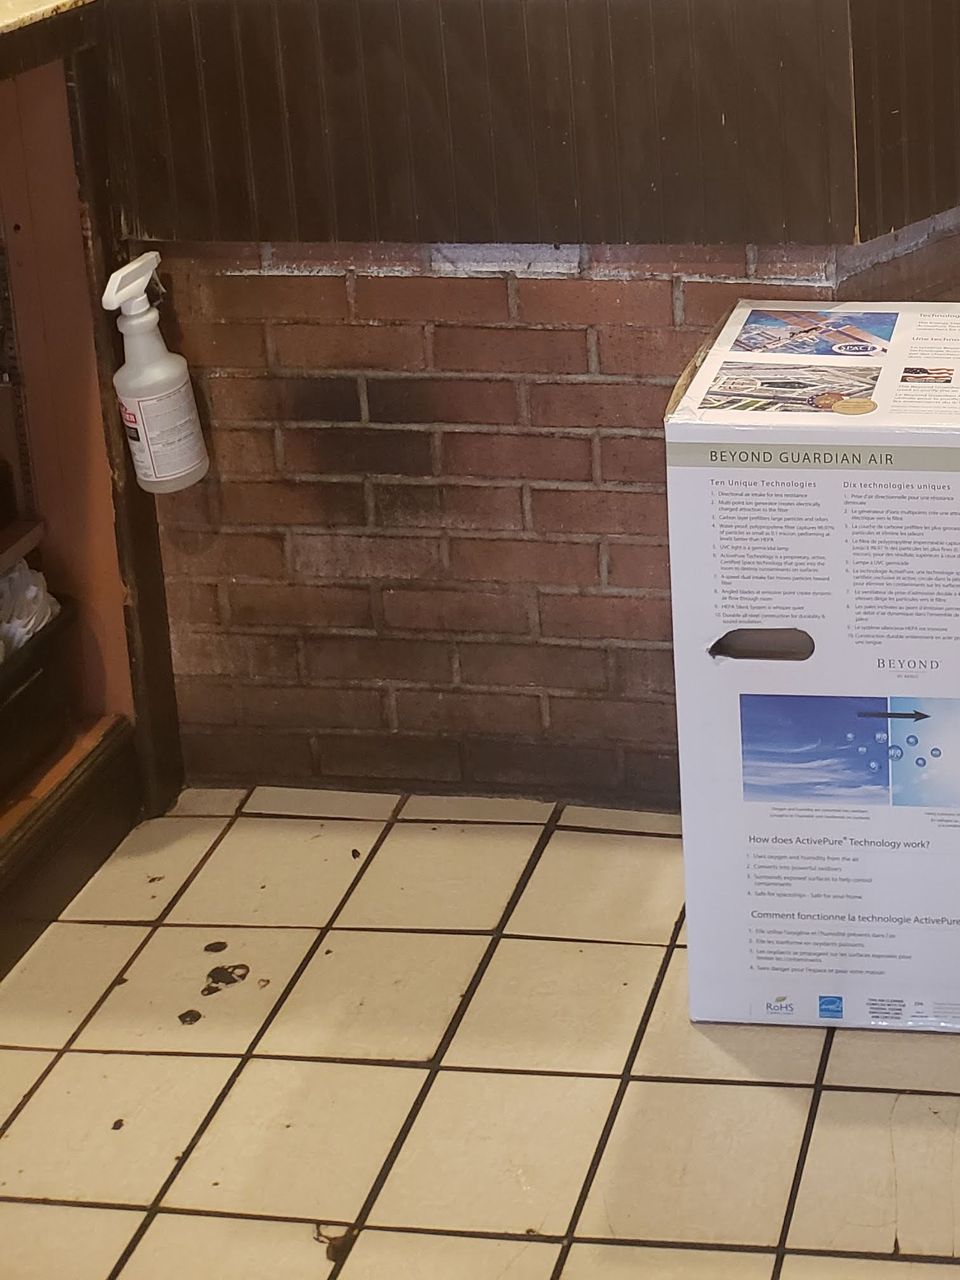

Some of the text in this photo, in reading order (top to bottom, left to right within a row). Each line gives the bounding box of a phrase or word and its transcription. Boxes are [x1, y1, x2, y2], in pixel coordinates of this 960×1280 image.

[710, 450, 894, 465] BEYOND GUARDIAN AIR
[728, 480, 758, 488] Unique
[761, 480, 817, 489] Technologies
[843, 481, 951, 491] Dix technologies uniques
[878, 658, 939, 669] BEYOND
[749, 835, 770, 845] How
[771, 836, 793, 845] does
[849, 838, 901, 849] Technology
[903, 839, 930, 849] work?
[751, 910, 795, 920] Comment
[797, 911, 846, 921] fonctionne
[848, 913, 856, 922] la
[858, 914, 911, 925] technologie
[766, 1003, 794, 1011] RoHS
